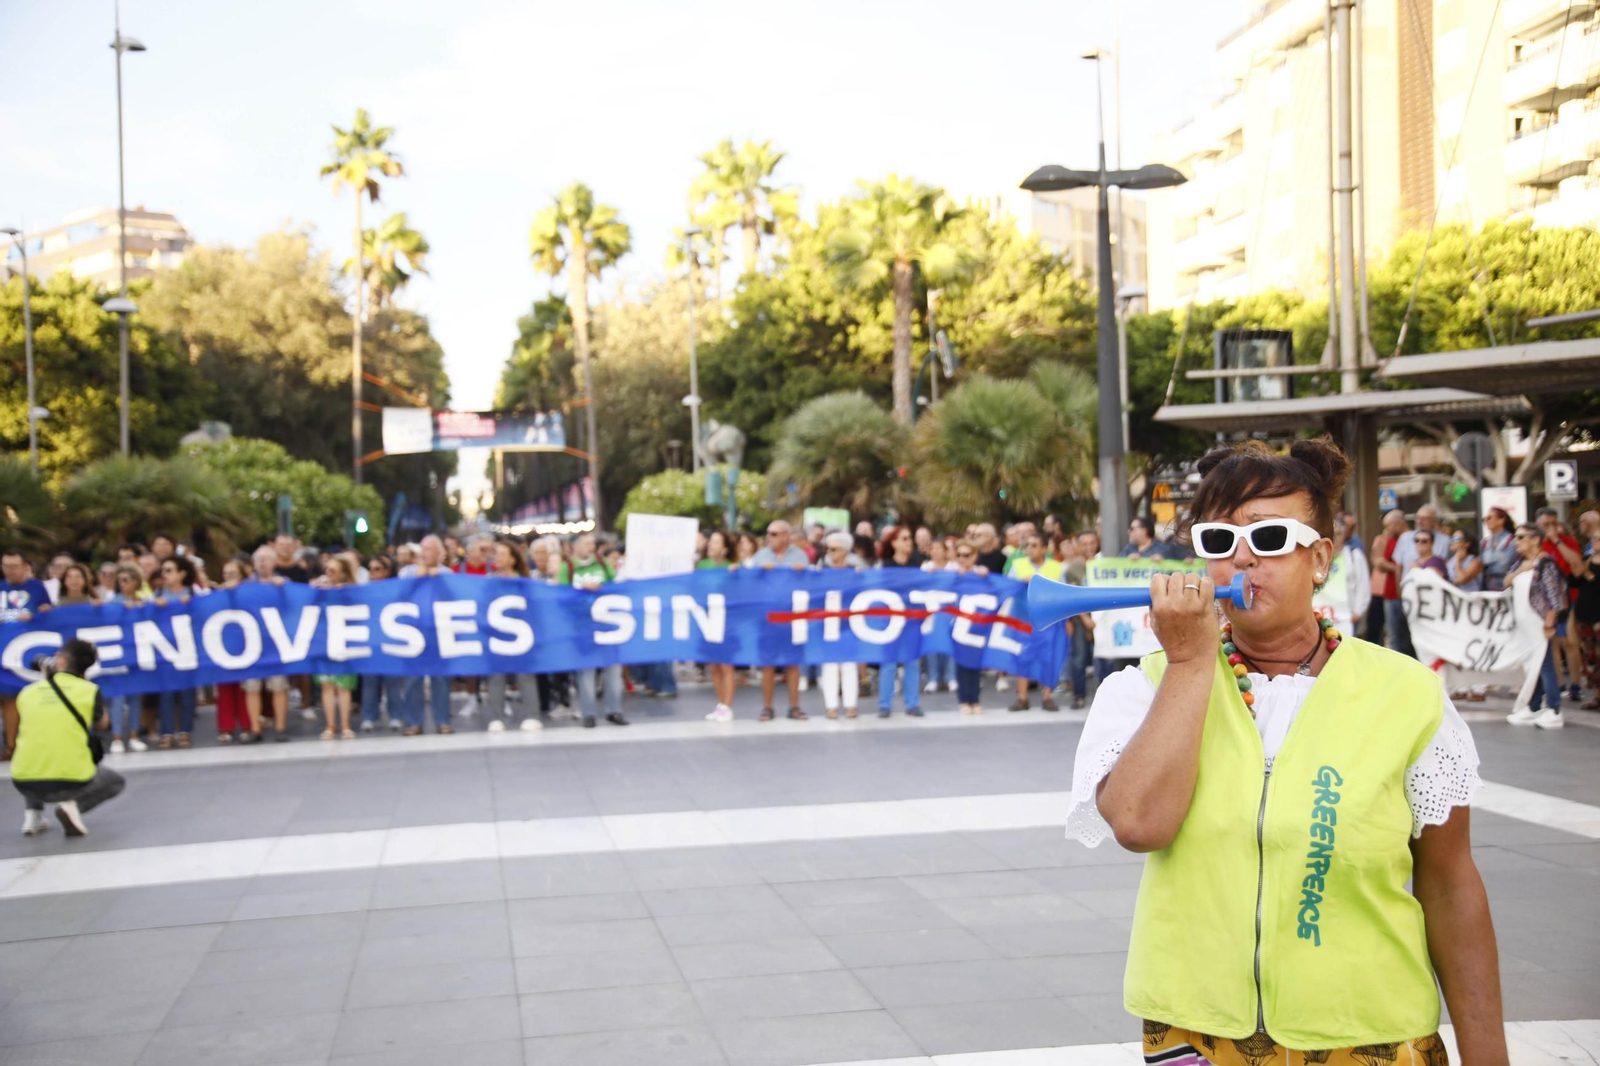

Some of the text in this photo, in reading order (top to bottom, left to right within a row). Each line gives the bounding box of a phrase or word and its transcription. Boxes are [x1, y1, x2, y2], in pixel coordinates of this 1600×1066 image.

[1550, 462, 1575, 492] P
[1093, 566, 1117, 579] Los
[2, 589, 1022, 682] GENOVESES SIN HOTEL
[1465, 637, 1505, 672] SIN
[1297, 765, 1343, 947] GREENPEACE
